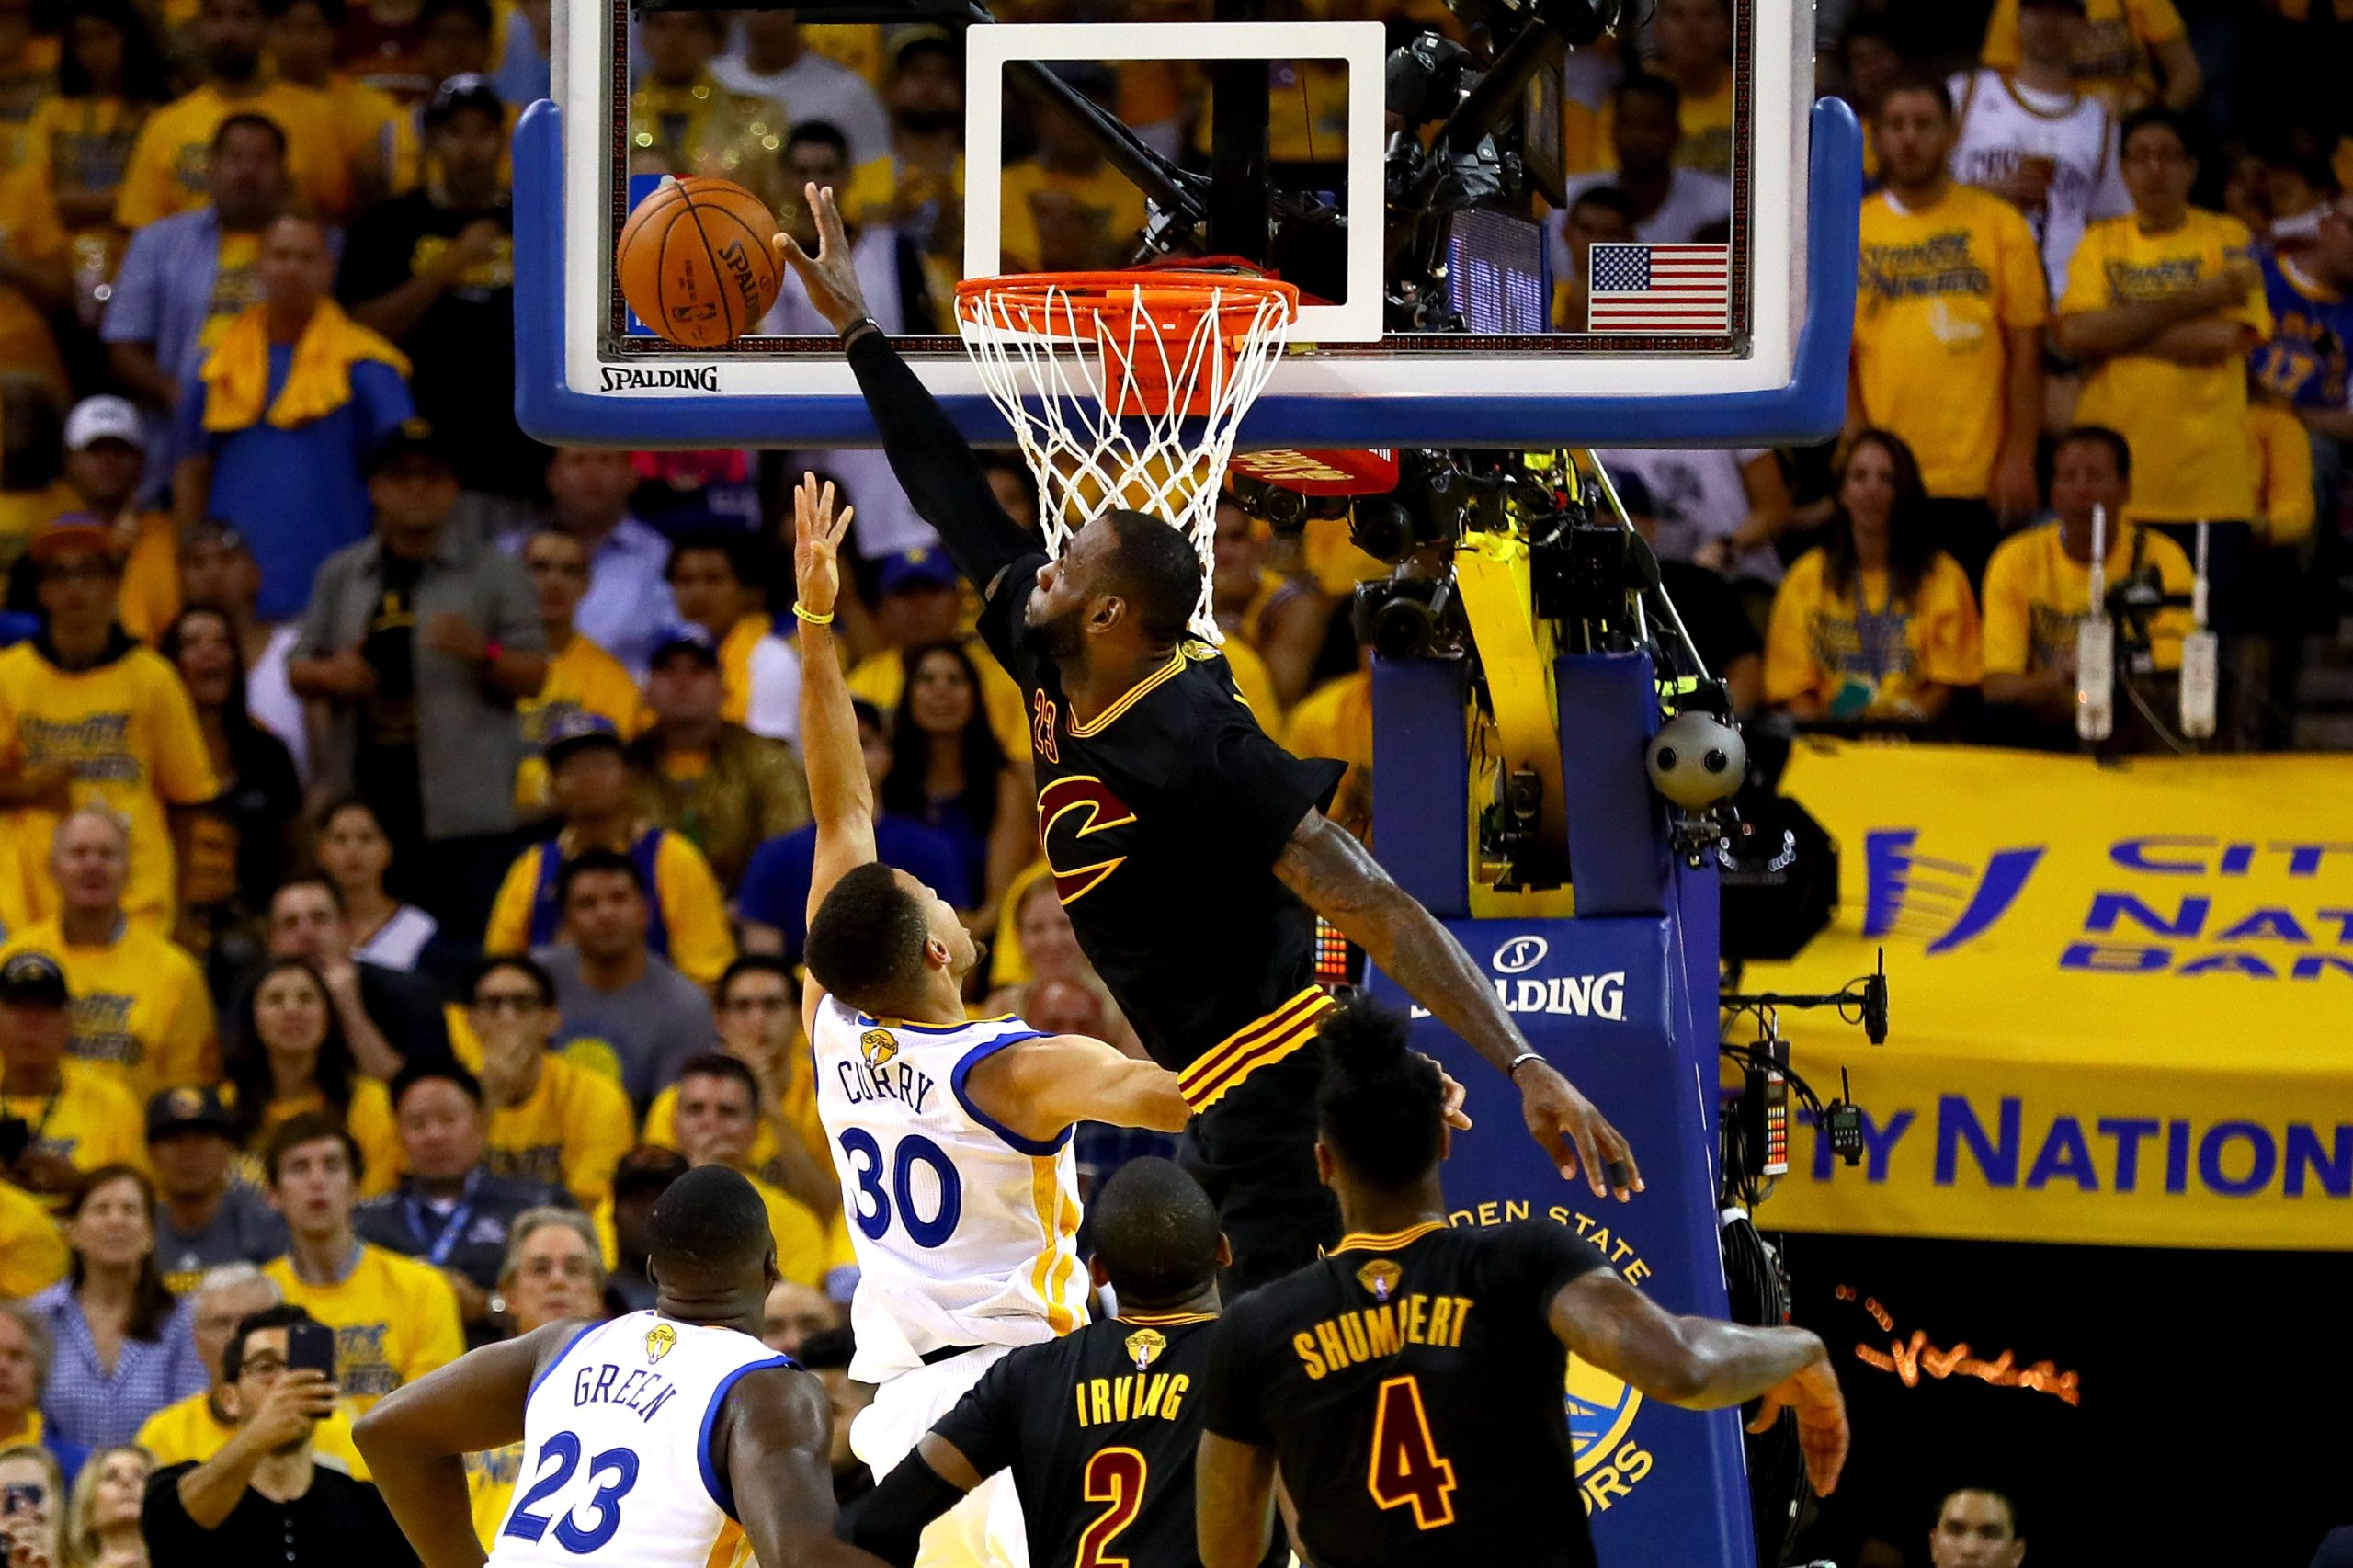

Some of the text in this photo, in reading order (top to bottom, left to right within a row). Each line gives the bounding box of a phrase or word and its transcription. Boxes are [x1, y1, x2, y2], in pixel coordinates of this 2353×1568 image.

[600, 366, 717, 392] SPALDING
[1034, 687, 1059, 764] 23
[1411, 971, 1627, 1021] LDING
[837, 1061, 934, 1115] CURRY
[1796, 1108, 1915, 1183] TY
[837, 1127, 961, 1248] 30
[1449, 1199, 1652, 1287] DEN STATE
[574, 1364, 677, 1424] GREEN
[1075, 1372, 1190, 1427] IRVING
[1368, 1375, 1457, 1530] 4
[503, 1430, 641, 1555] 23
[1074, 1446, 1148, 1568] 2
